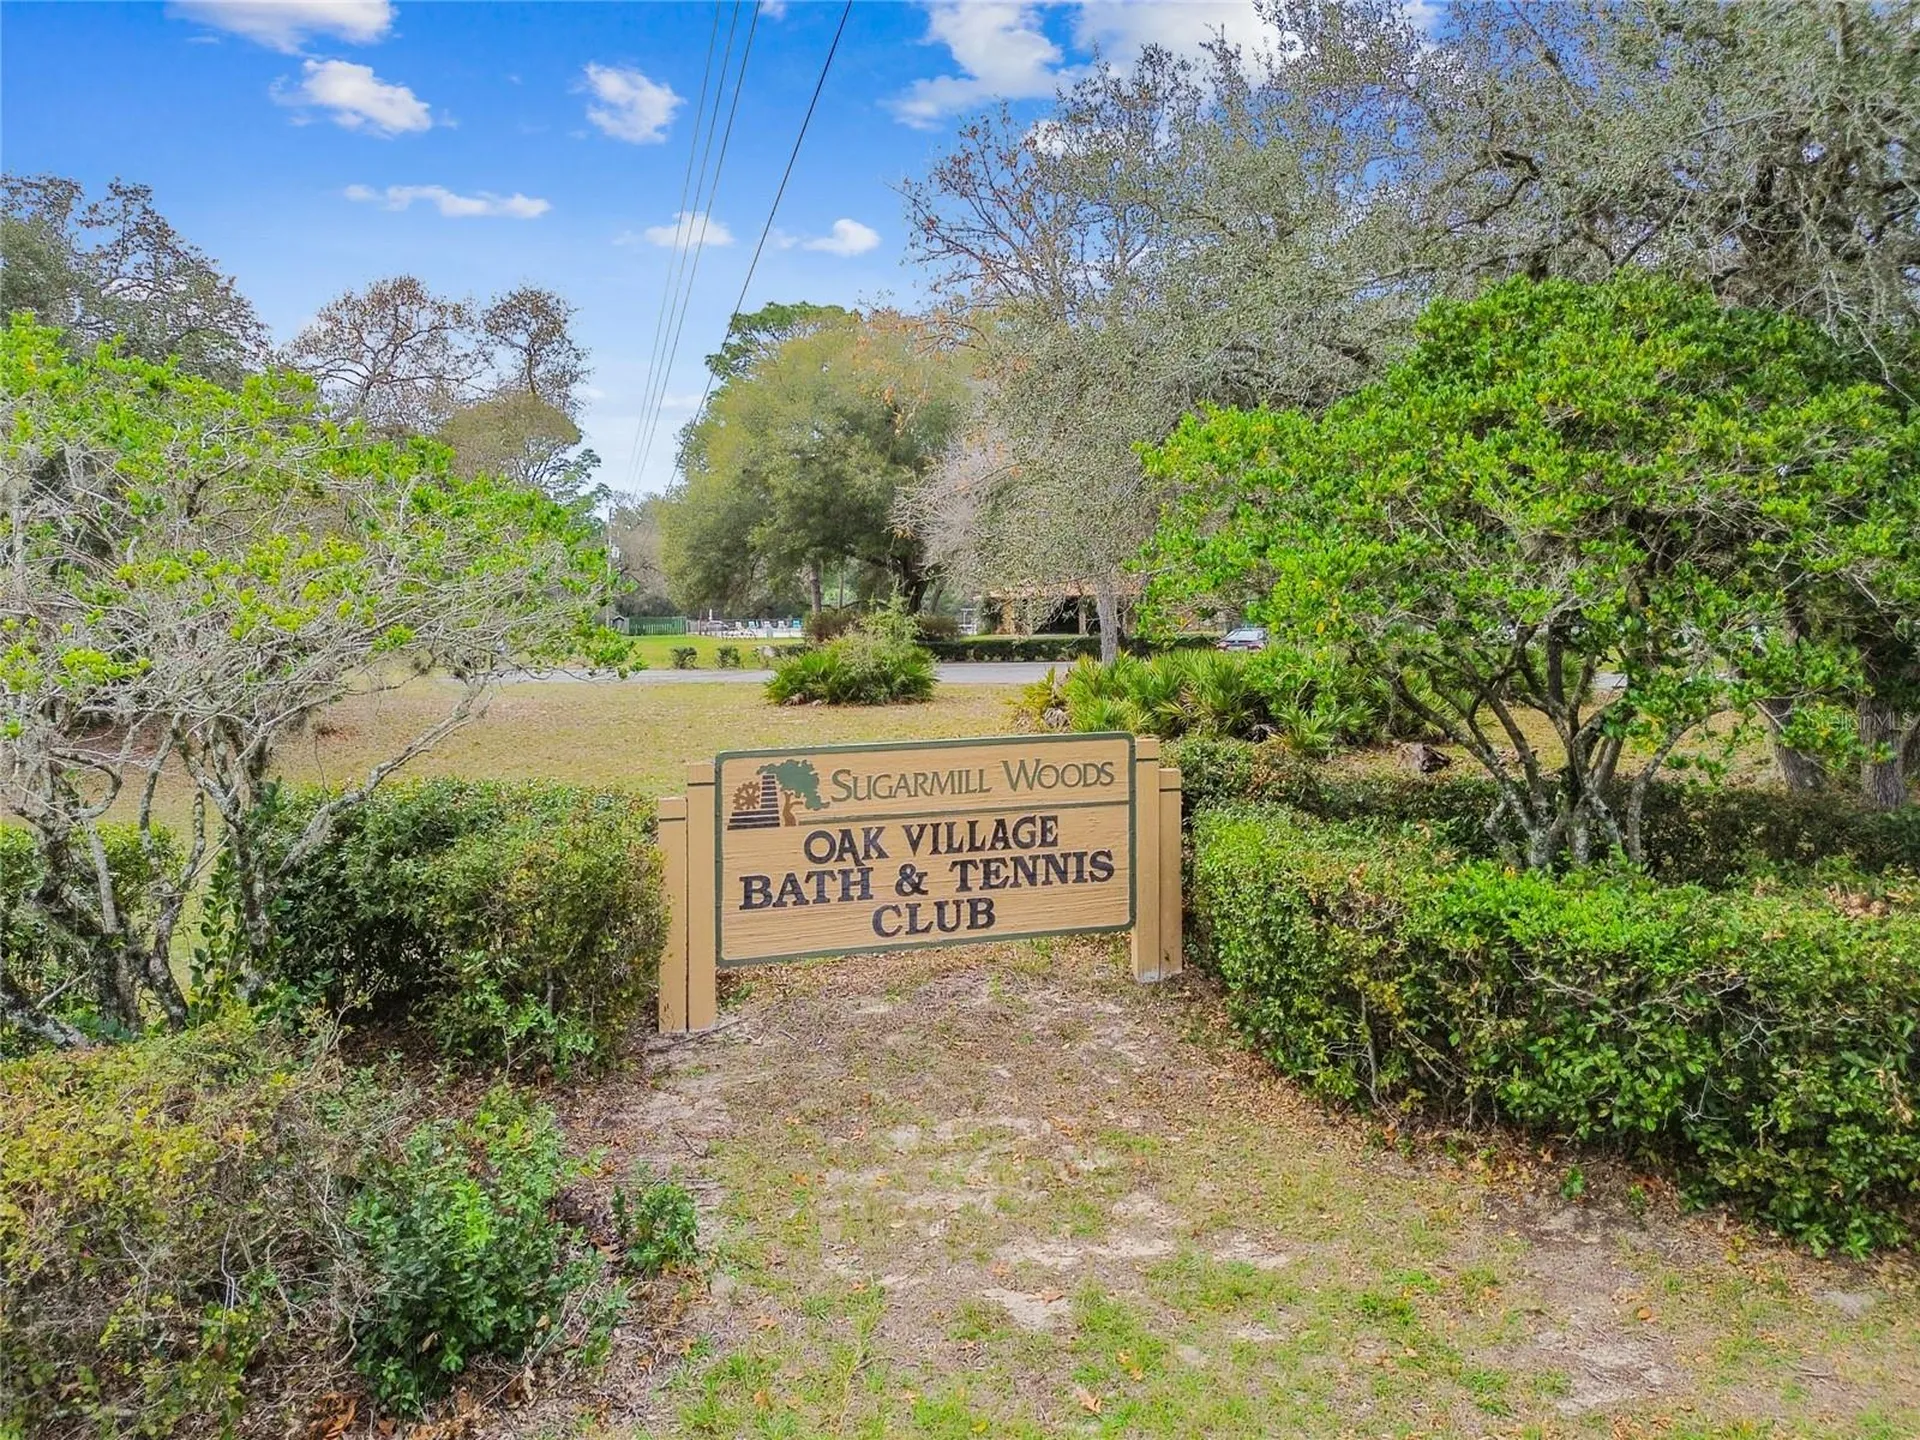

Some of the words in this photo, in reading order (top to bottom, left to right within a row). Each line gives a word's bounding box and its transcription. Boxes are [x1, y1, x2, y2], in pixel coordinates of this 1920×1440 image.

[831, 769, 993, 801] SUGARMILL
[1001, 758, 1115, 791] WOODS
[803, 825, 890, 866] OAK
[902, 815, 1059, 856] VILLAGE
[739, 866, 874, 910] BATH
[895, 863, 929, 896] &
[948, 849, 1115, 893] TENNIS
[872, 897, 996, 938] CLUB
